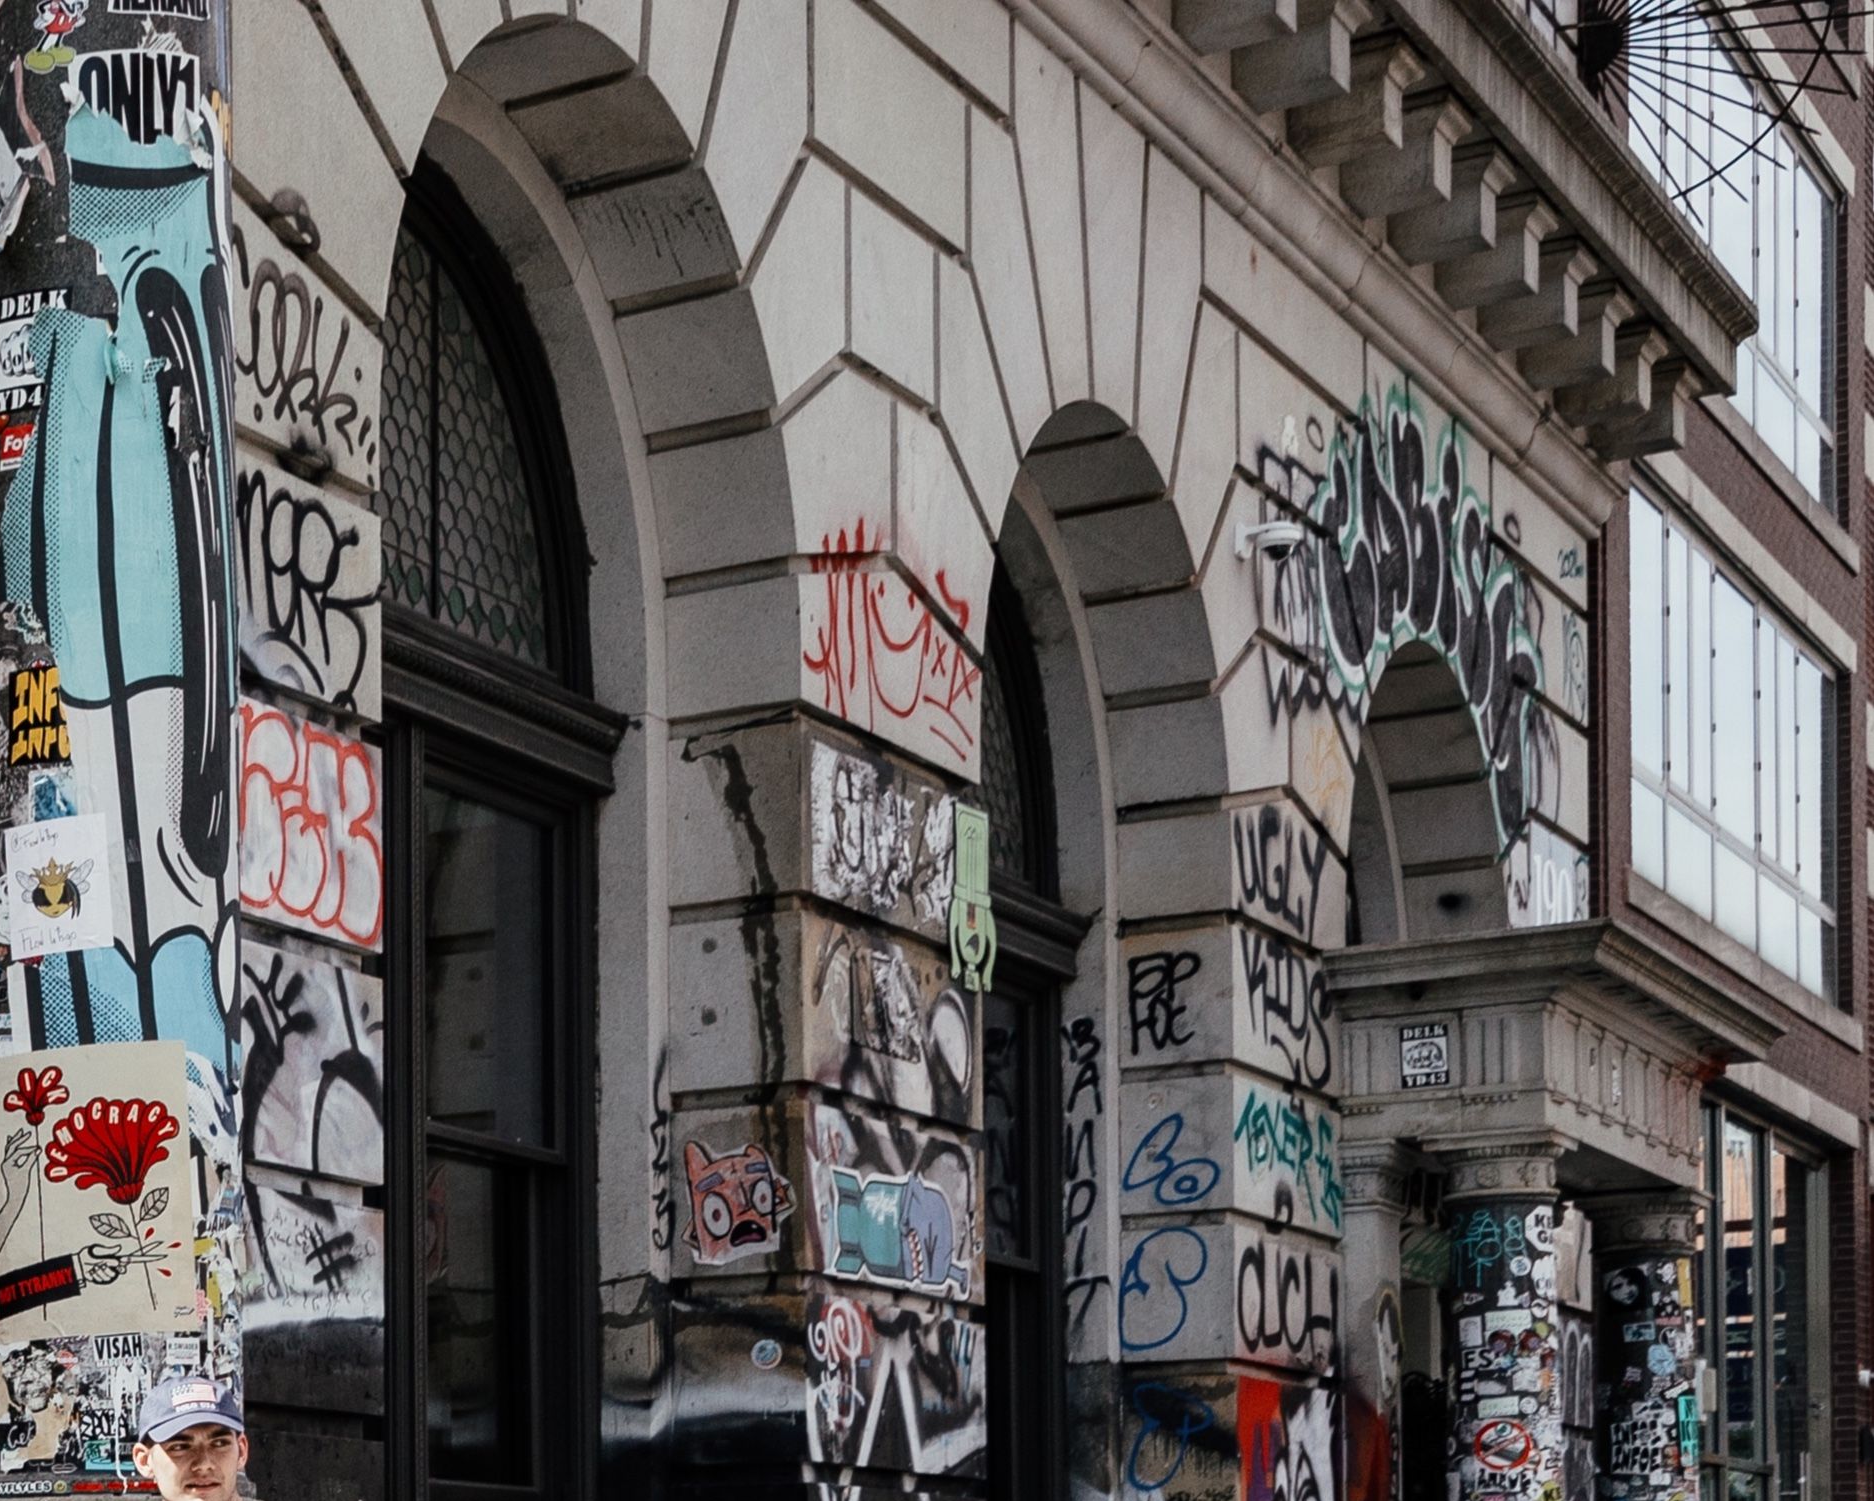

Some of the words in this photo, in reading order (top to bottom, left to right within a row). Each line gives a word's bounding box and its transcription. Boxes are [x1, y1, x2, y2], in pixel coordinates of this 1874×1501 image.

[0, 289, 68, 320] DELK
[1237, 806, 1331, 948] UGLY
[1403, 1024, 1445, 1039] DELK
[6, 1069, 68, 1107] PICK
[1406, 1072, 1446, 1087] YD43
[50, 1101, 175, 1178] DEMOCRACY
[18, 1266, 74, 1297] TYRANNY
[94, 1335, 143, 1360] VISAH
